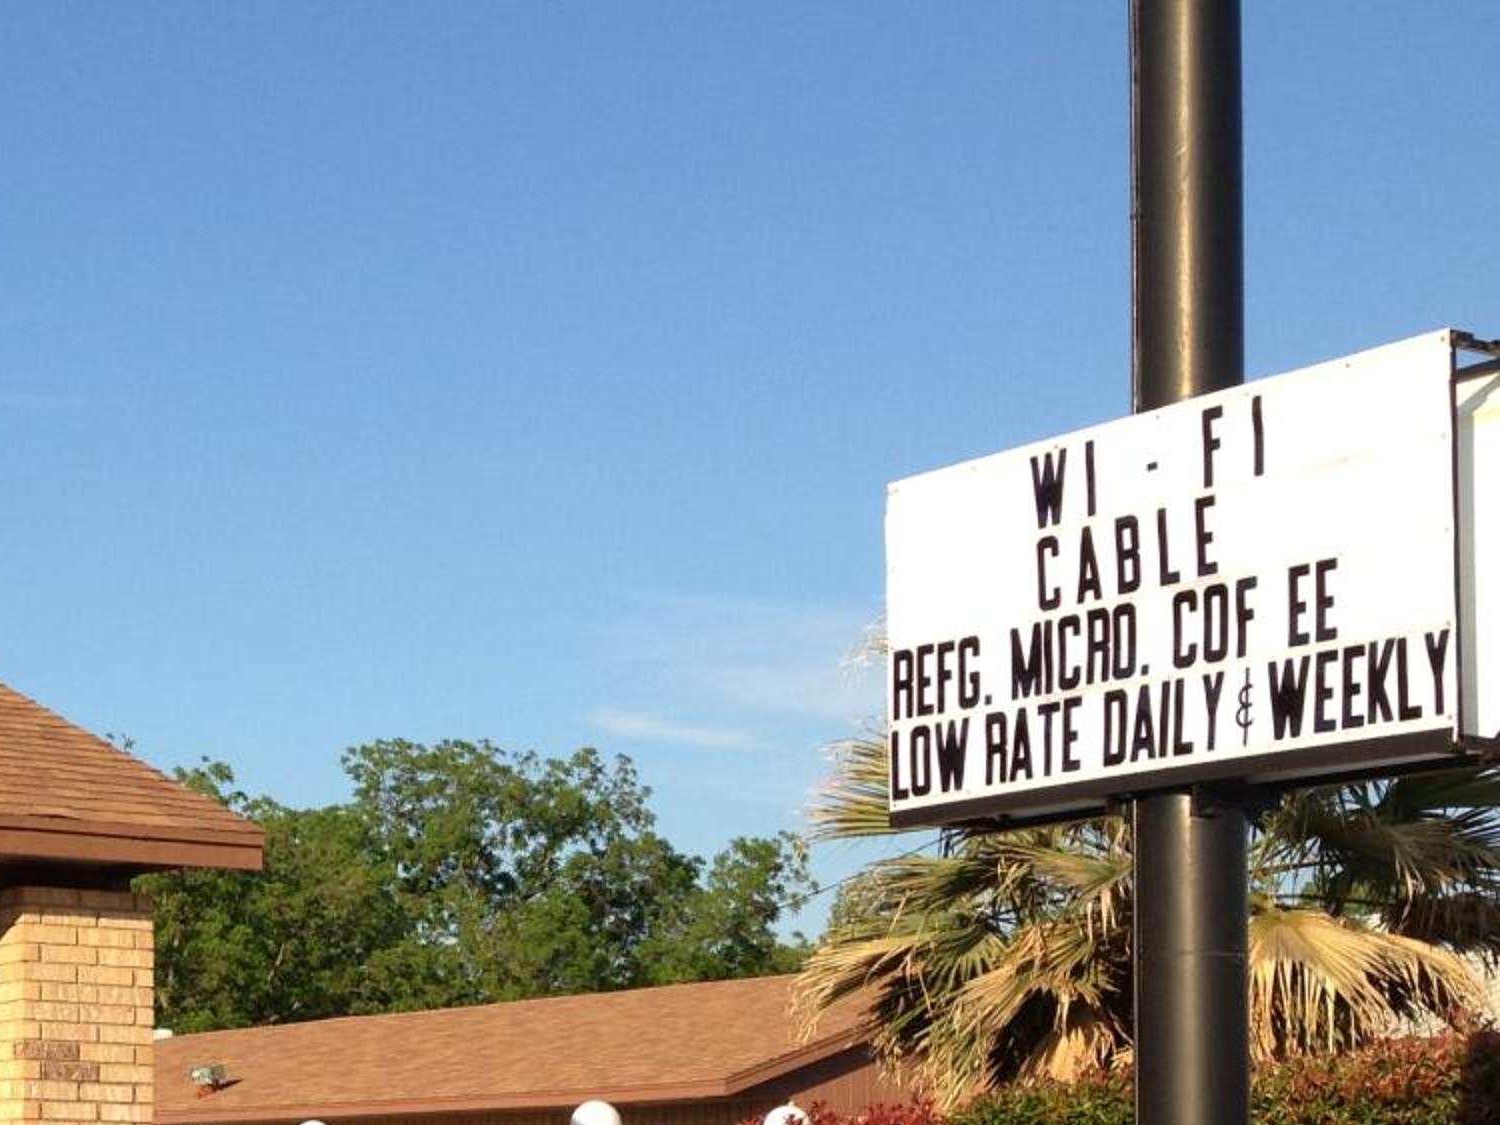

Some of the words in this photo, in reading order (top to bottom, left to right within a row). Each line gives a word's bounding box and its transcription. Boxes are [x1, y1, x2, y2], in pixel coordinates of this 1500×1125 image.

[1035, 495, 1219, 612] CABLE
[890, 716, 971, 802] LOW
[984, 696, 1082, 785] RATE
[1102, 671, 1226, 768] DAILY
[1267, 628, 1451, 742] WEEKLY
[892, 635, 993, 722] REFG.
[1009, 602, 1150, 702] MICRO.
